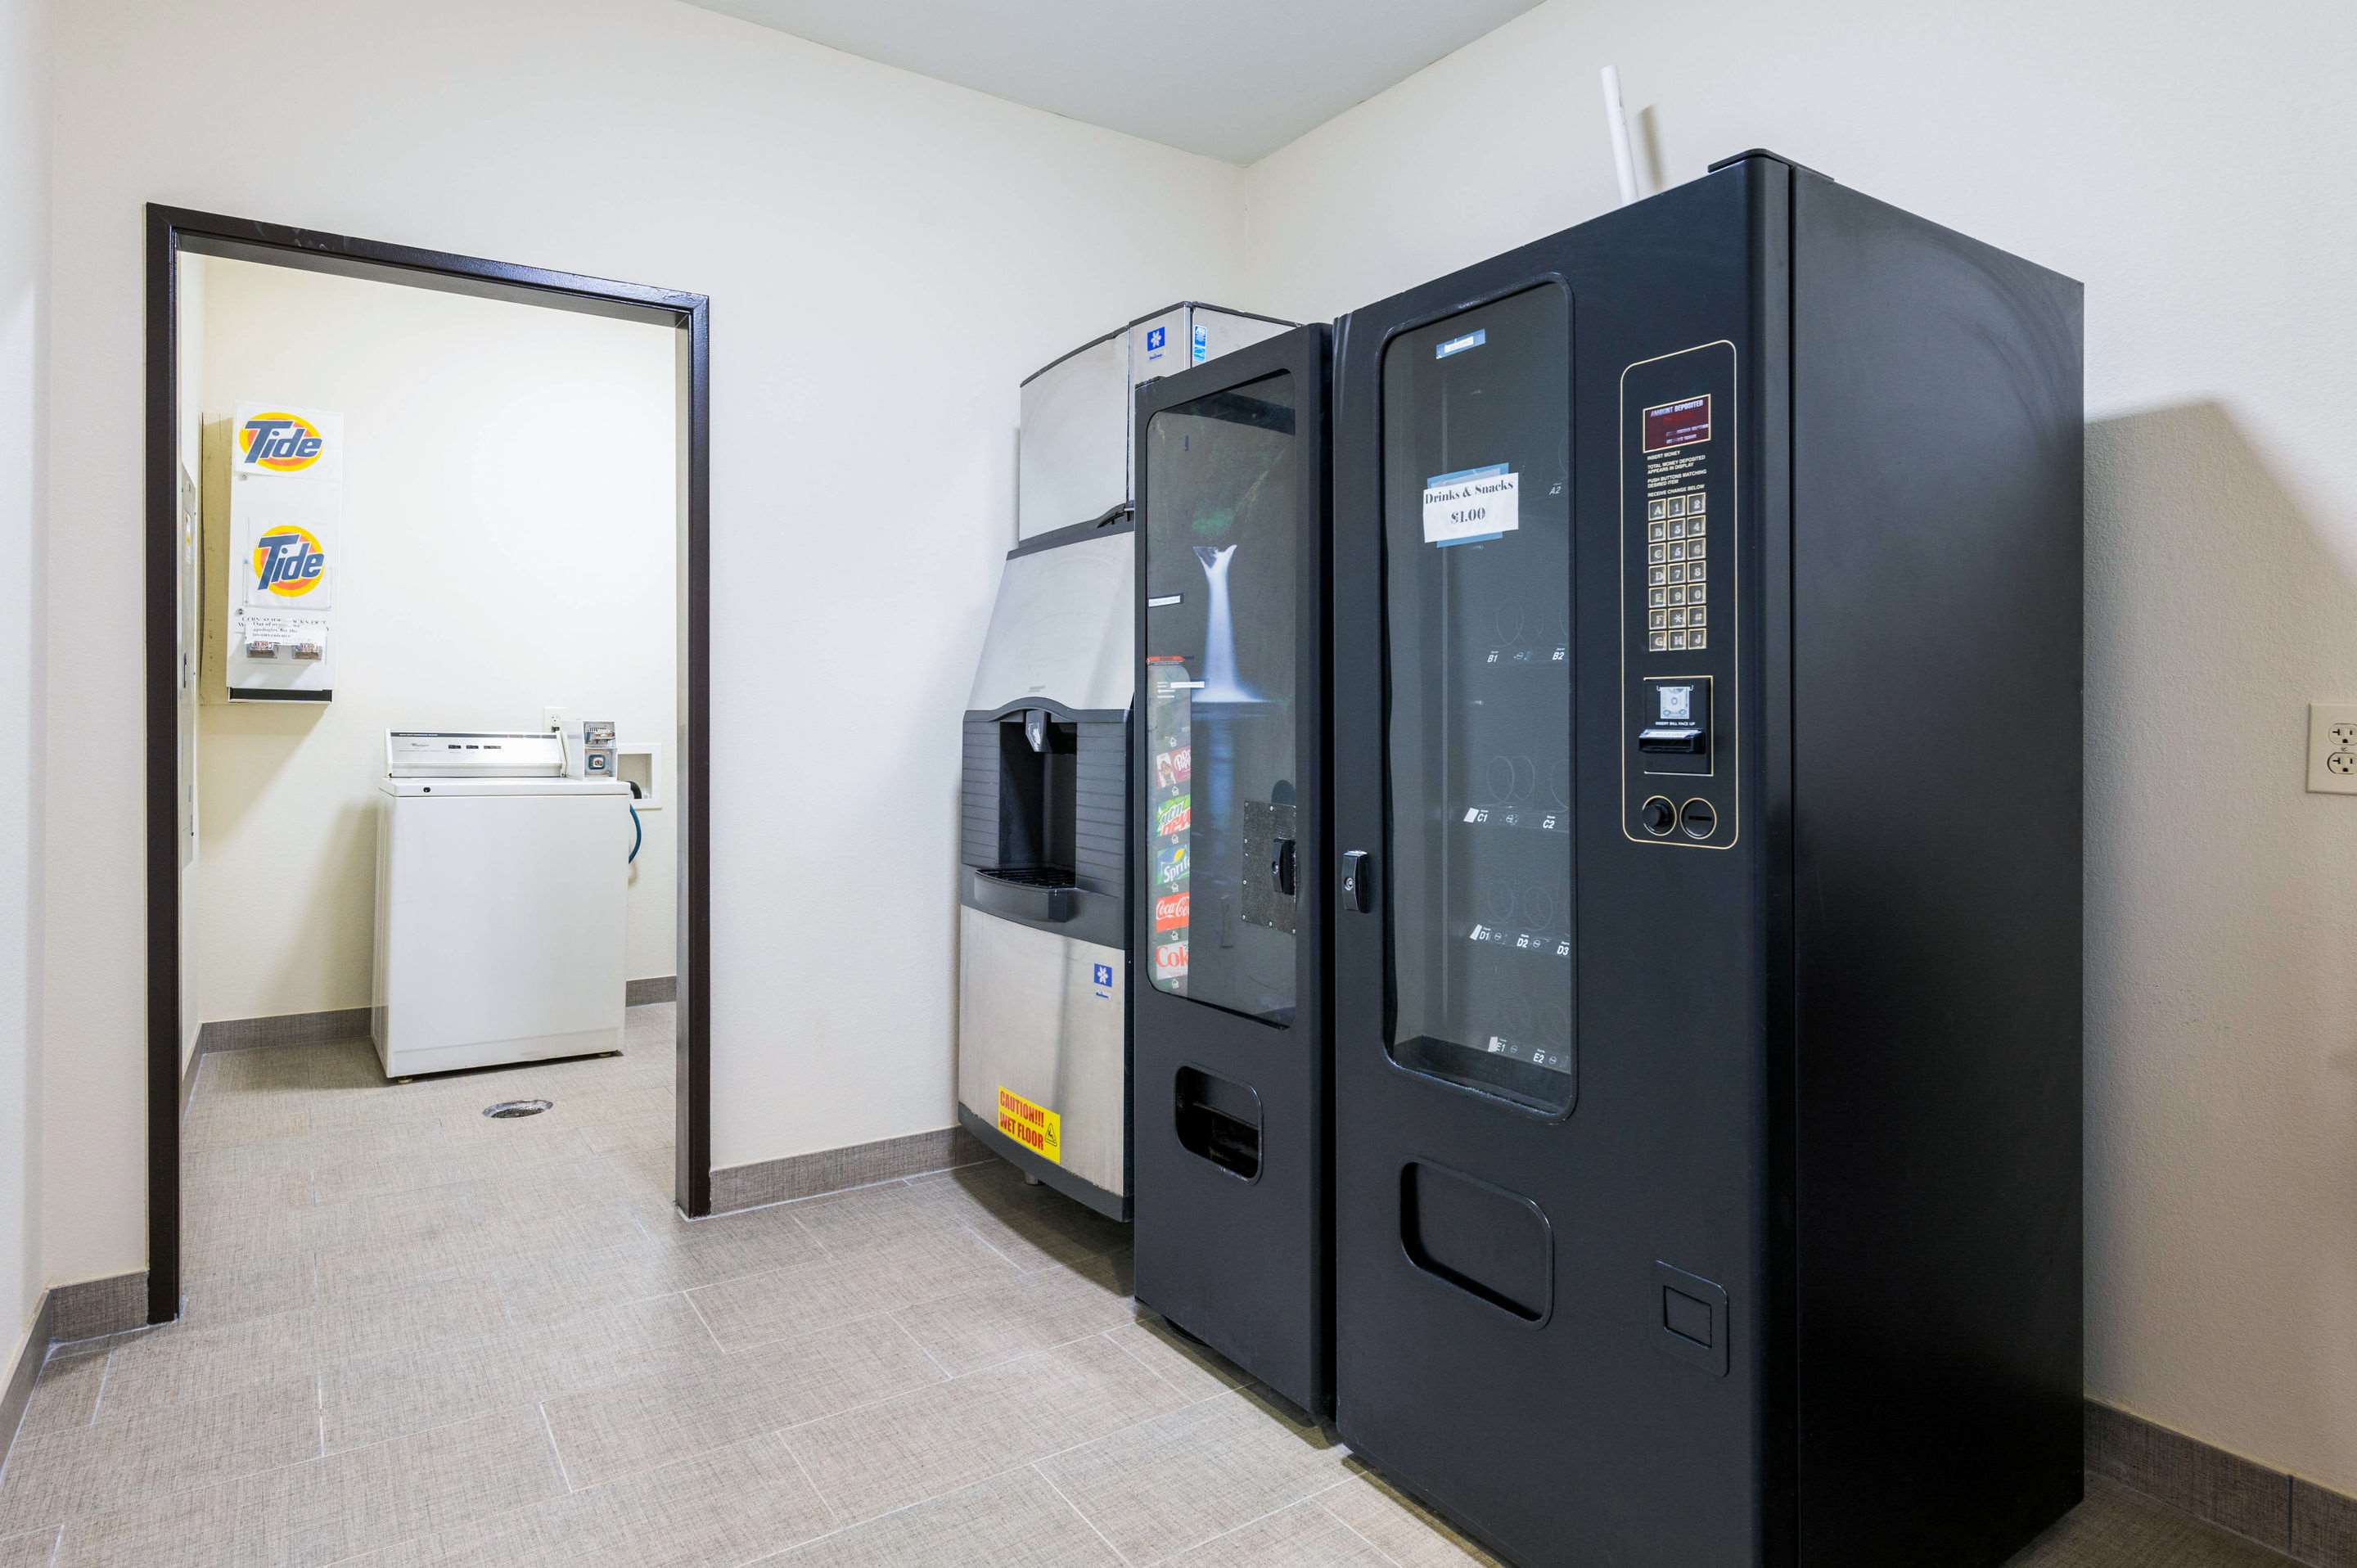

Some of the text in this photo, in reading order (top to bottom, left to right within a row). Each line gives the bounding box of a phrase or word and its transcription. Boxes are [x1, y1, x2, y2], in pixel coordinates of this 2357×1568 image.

[1674, 399, 1704, 412] DEPOSITED
[244, 420, 323, 464] Tide
[1679, 455, 1706, 464] DEPOSITED
[1647, 466, 1669, 475] APPEARS
[1674, 462, 1694, 470] DISPLAY
[1683, 468, 1707, 478] MATCHING
[1425, 480, 1514, 505] Drinks & Snacks
[1548, 486, 1562, 495] A2
[1674, 503, 1679, 512] 1
[1693, 499, 1701, 509] 2
[1654, 506, 1662, 515] A
[1450, 507, 1486, 525] $1.00
[1693, 522, 1700, 531] 4
[1655, 528, 1662, 537] B
[1654, 549, 1663, 559] C
[1693, 545, 1701, 554] 6
[256, 534, 325, 590] Tide
[1655, 571, 1663, 581] D
[1674, 570, 1681, 579] 7
[1695, 567, 1701, 577] 8
[1656, 593, 1663, 602] E
[1694, 589, 1701, 599] 0
[1656, 615, 1663, 624] F
[1655, 637, 1663, 646] G
[1674, 636, 1683, 645] H
[1695, 634, 1701, 644] J
[1487, 654, 1498, 664] B1
[1553, 651, 1565, 660] B2
[1477, 813, 1489, 823] C1
[1543, 820, 1555, 830] C2
[1479, 930, 1490, 940] D1
[1517, 938, 1529, 948] D2
[1557, 945, 1569, 956] D3
[1154, 944, 1188, 968] Cok
[1533, 1052, 1545, 1064] E2
[1000, 1090, 1044, 1128] CAUTION!!!
[1000, 1111, 1043, 1151] WET FLOOR
